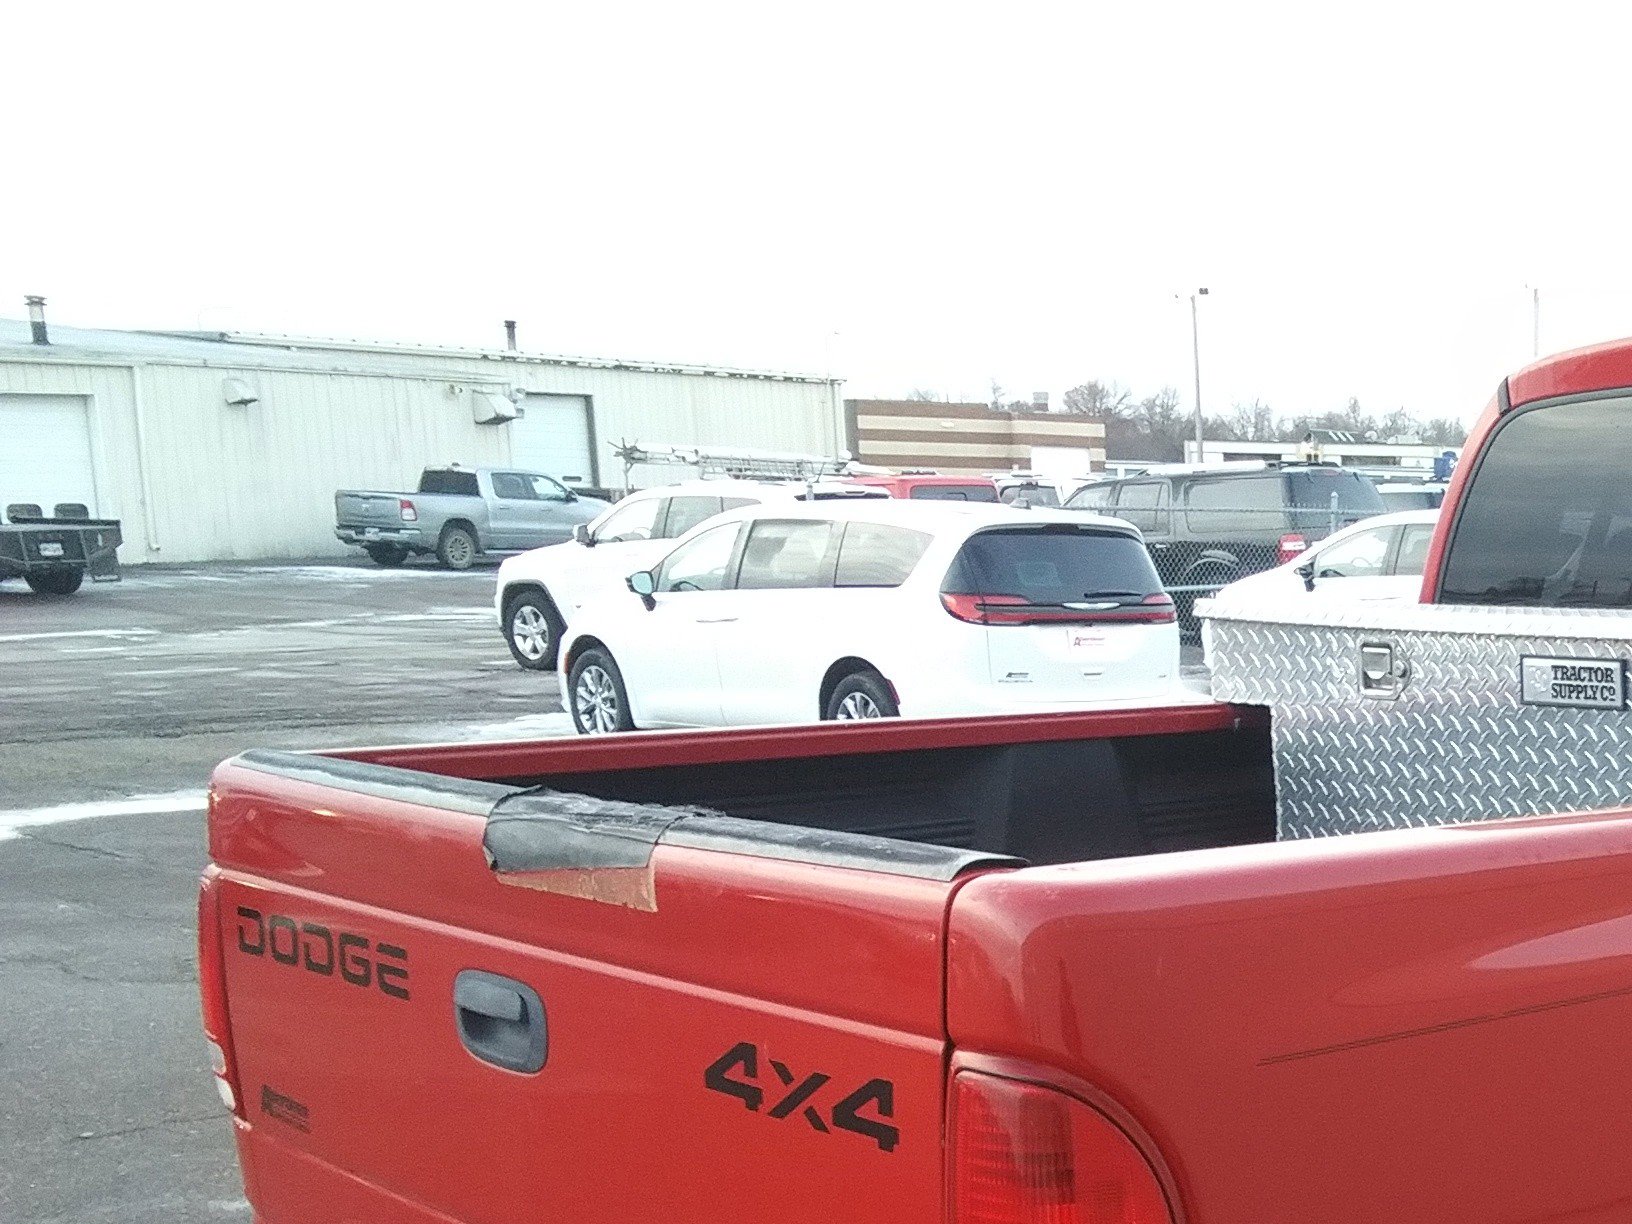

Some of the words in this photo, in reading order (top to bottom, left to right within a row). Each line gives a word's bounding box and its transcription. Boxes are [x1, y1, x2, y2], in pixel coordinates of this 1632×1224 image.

[1551, 665, 1615, 684] TRACTOR
[1551, 683, 1599, 701] SUPPLY
[237, 905, 411, 1000] DODGE
